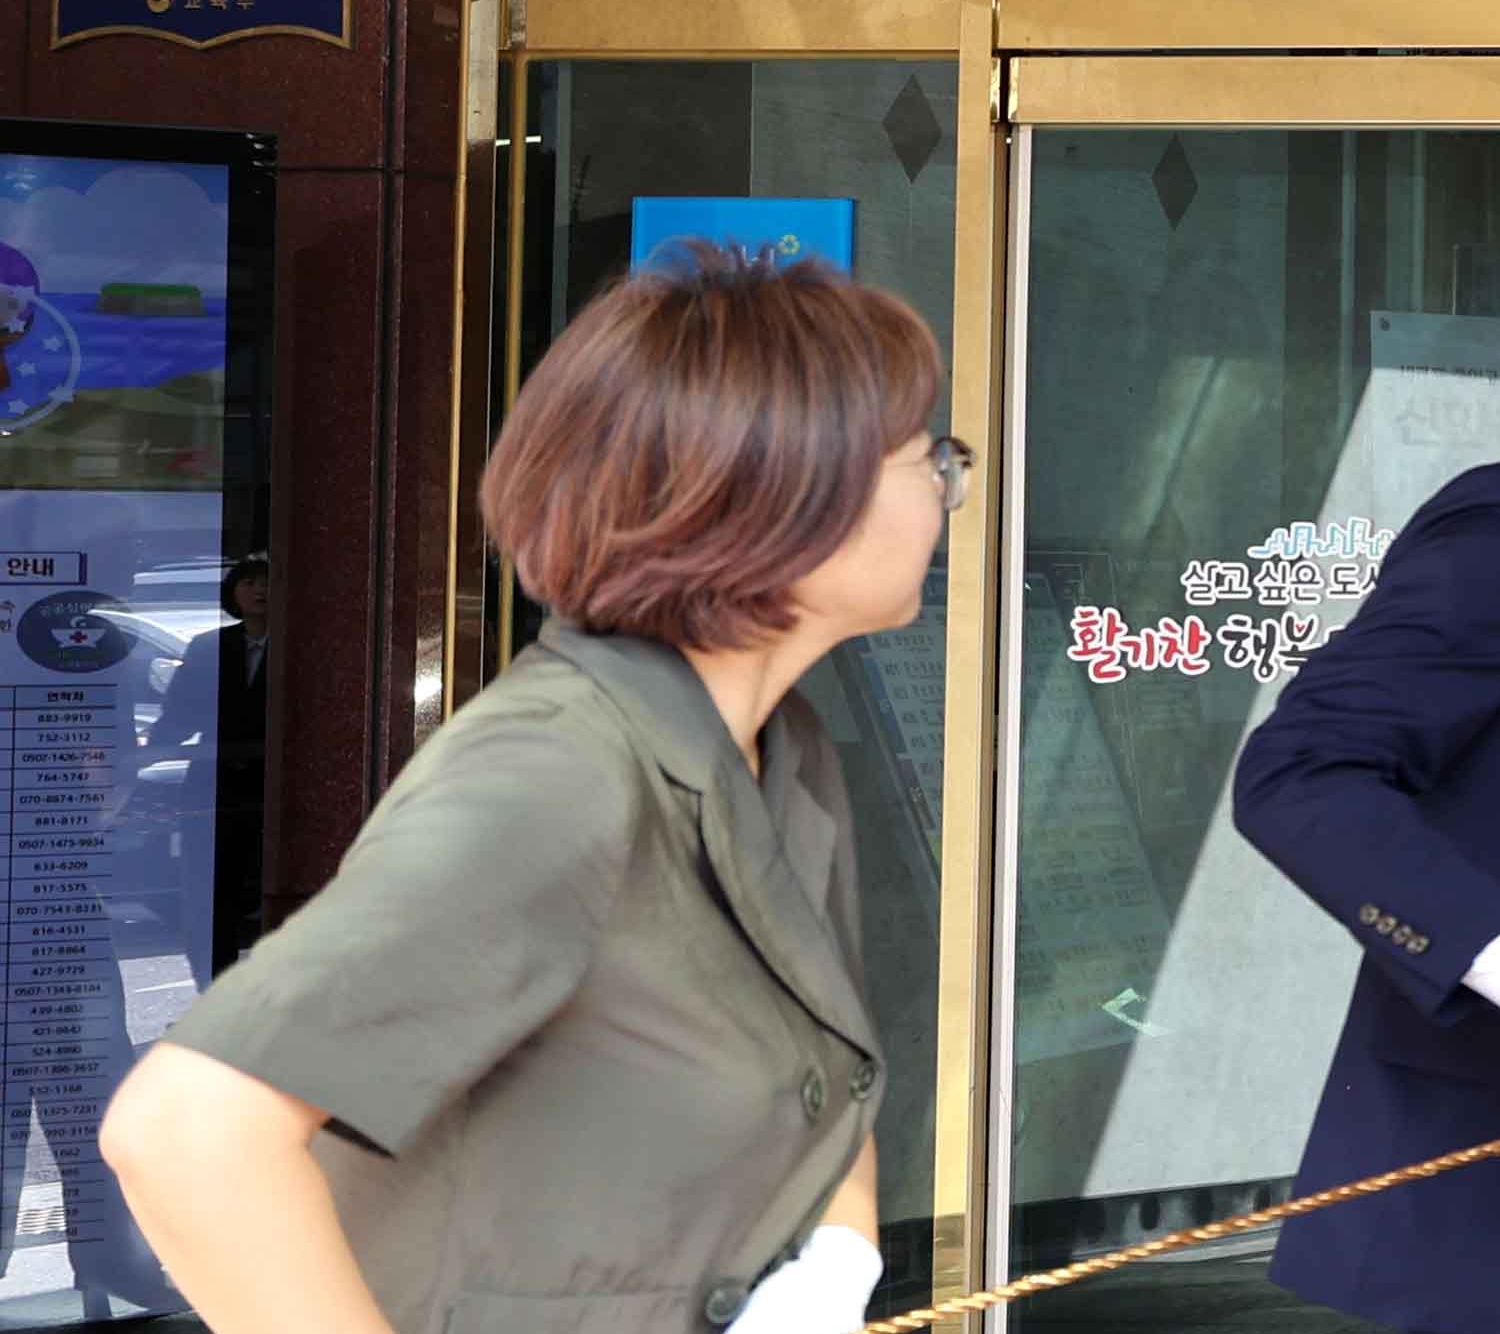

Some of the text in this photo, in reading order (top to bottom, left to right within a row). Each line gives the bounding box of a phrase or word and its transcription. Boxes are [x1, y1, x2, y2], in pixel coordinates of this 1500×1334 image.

[1185, 563, 1250, 603] 살고
[1257, 562, 1320, 603] 싶은
[1071, 609, 1207, 679] 활기찬
